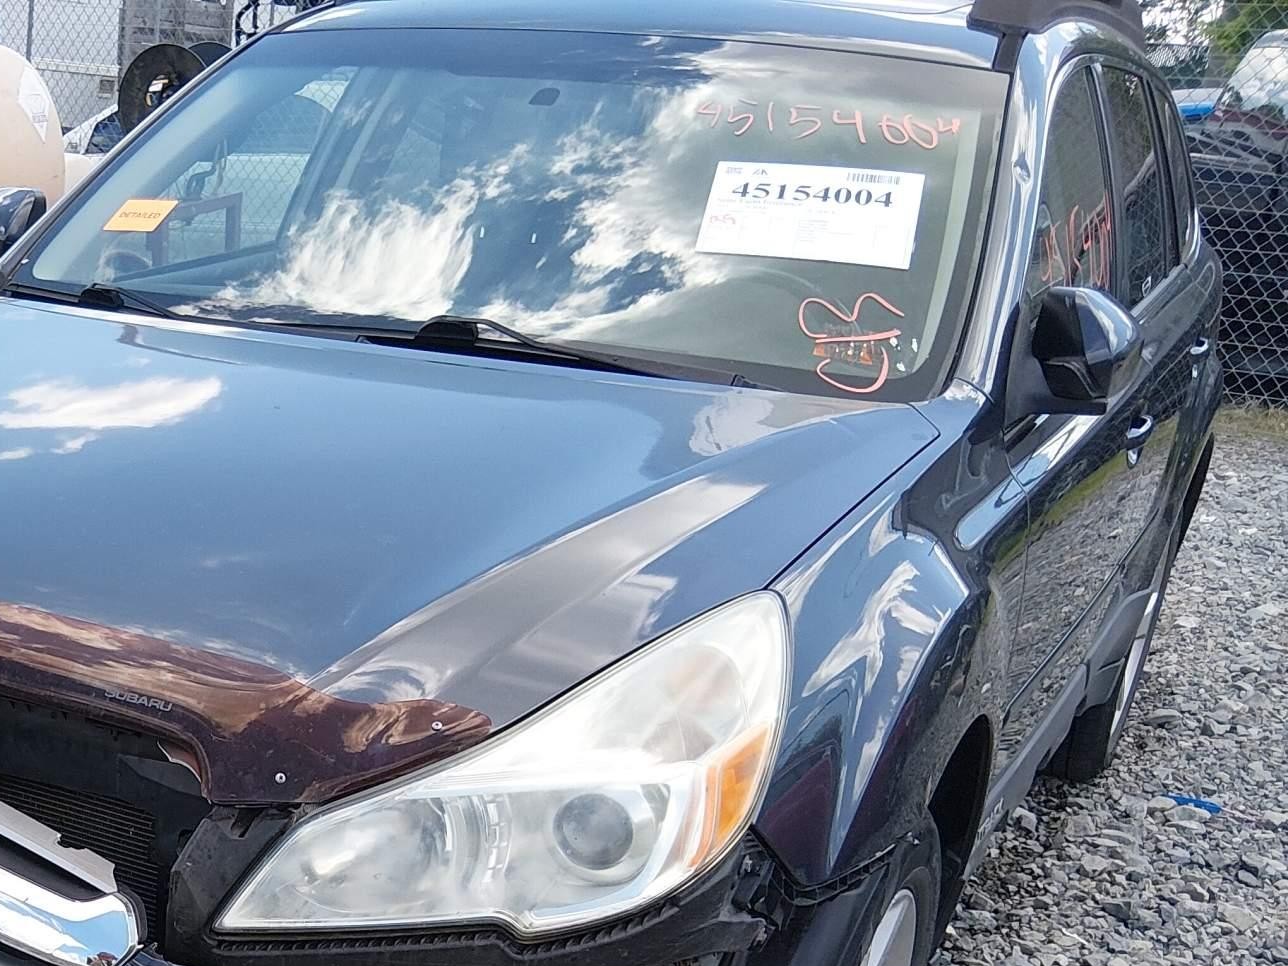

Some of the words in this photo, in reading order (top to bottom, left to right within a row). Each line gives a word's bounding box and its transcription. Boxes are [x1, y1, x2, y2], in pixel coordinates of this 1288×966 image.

[697, 97, 961, 150] 45154004
[731, 181, 894, 208] 45154004
[118, 211, 161, 219] DETAILED
[104, 688, 173, 712] SUBARU
